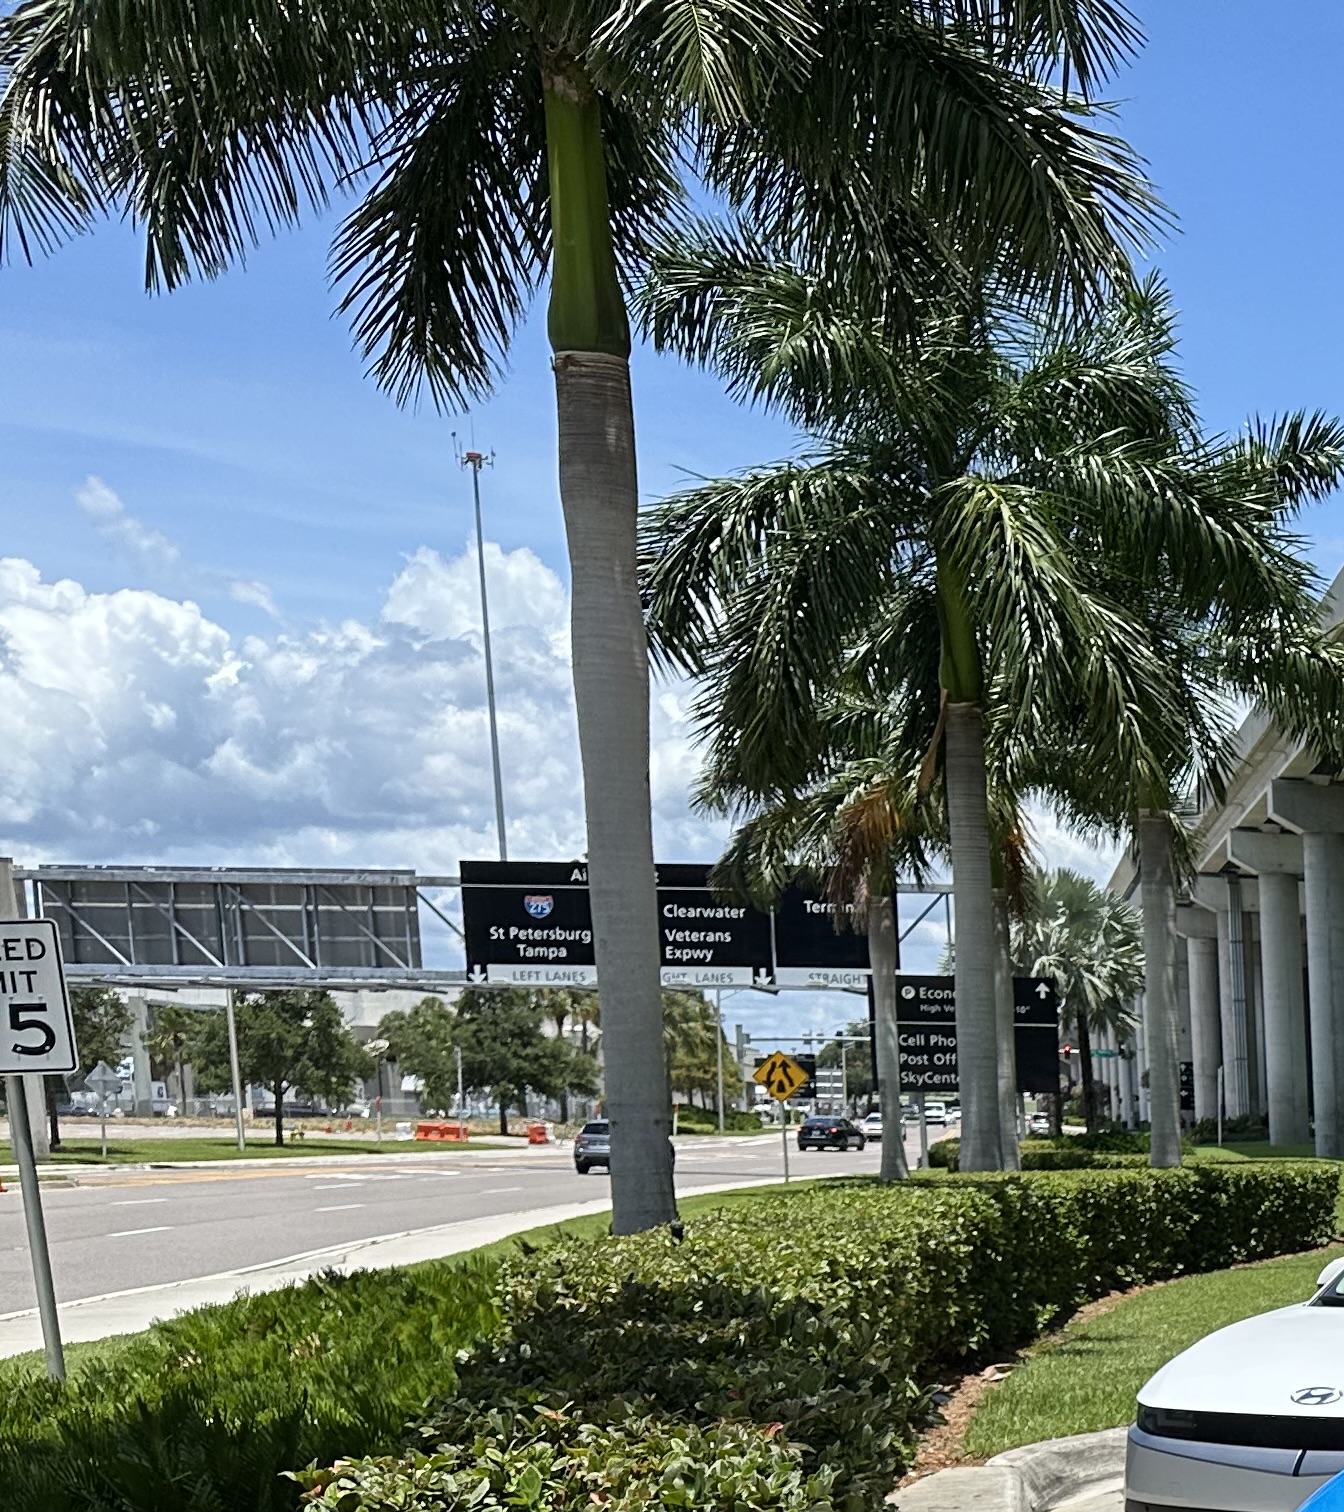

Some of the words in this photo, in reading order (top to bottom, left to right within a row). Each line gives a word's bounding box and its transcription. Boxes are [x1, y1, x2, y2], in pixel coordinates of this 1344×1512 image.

[529, 902, 551, 914] 275
[663, 904, 746, 919] Clearwater
[803, 899, 855, 914] Termin
[489, 925, 505, 940] St
[509, 926, 592, 944] Petersburg
[664, 928, 732, 942] Veterans
[0, 938, 46, 961] ED
[516, 943, 567, 960] Tampa
[665, 945, 714, 962] Expwy
[512, 970, 541, 982] LEFT
[545, 970, 586, 982] LANES
[695, 972, 734, 983] LANES
[919, 986, 956, 999] Econ
[920, 1004, 941, 1014] High
[943, 1004, 955, 1013] Ve
[899, 1034, 925, 1047] Cell
[930, 1034, 956, 1047] Pho
[899, 1053, 929, 1066] Post
[933, 1053, 956, 1066] Off
[901, 1071, 960, 1086] SkyCent
